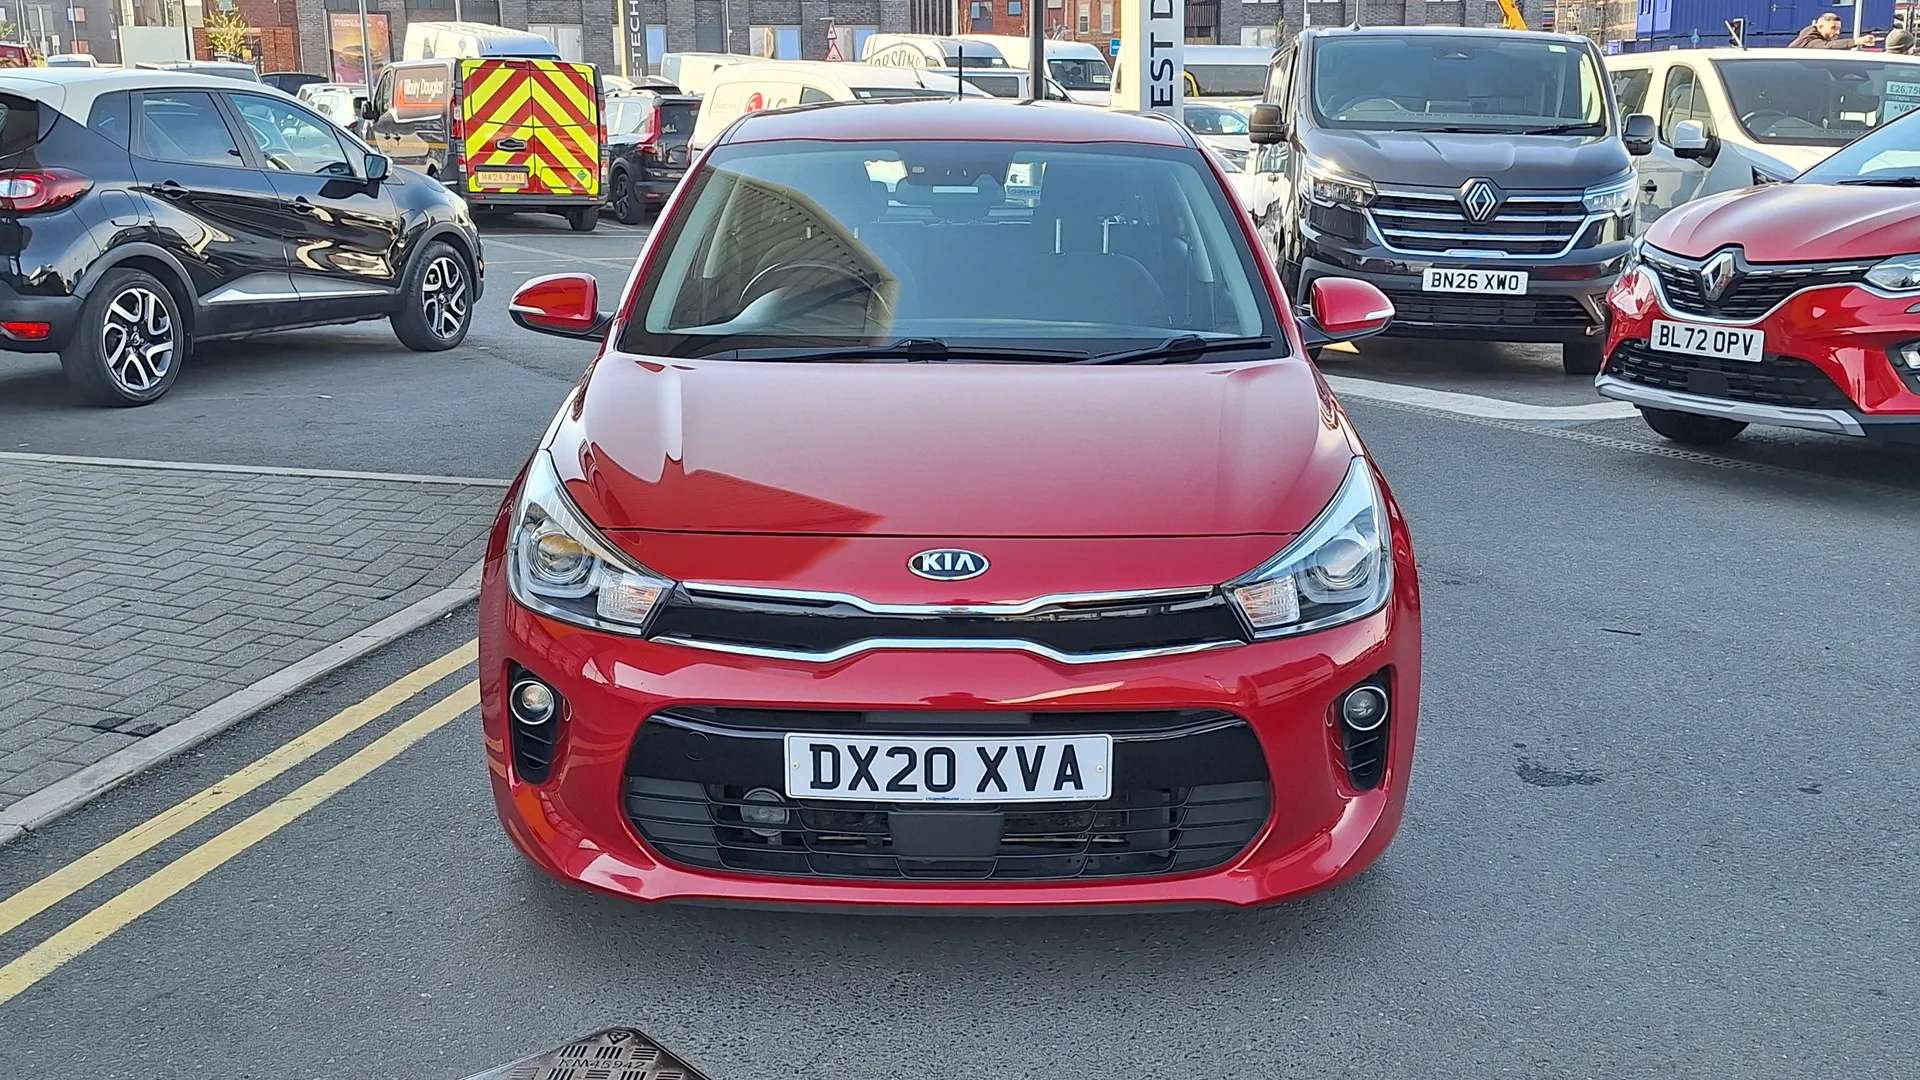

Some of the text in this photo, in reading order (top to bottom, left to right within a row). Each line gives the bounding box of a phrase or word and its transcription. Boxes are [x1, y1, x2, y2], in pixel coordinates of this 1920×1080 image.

[629, 0, 643, 80] E-TECH
[1150, 32, 1173, 108] EST
[420, 78, 443, 98] Douglas
[1431, 272, 1519, 291] BN26 XWO
[1659, 325, 1754, 356] BL72 OPV
[922, 553, 976, 571] KIA
[809, 743, 1084, 792] DX20 XVA
